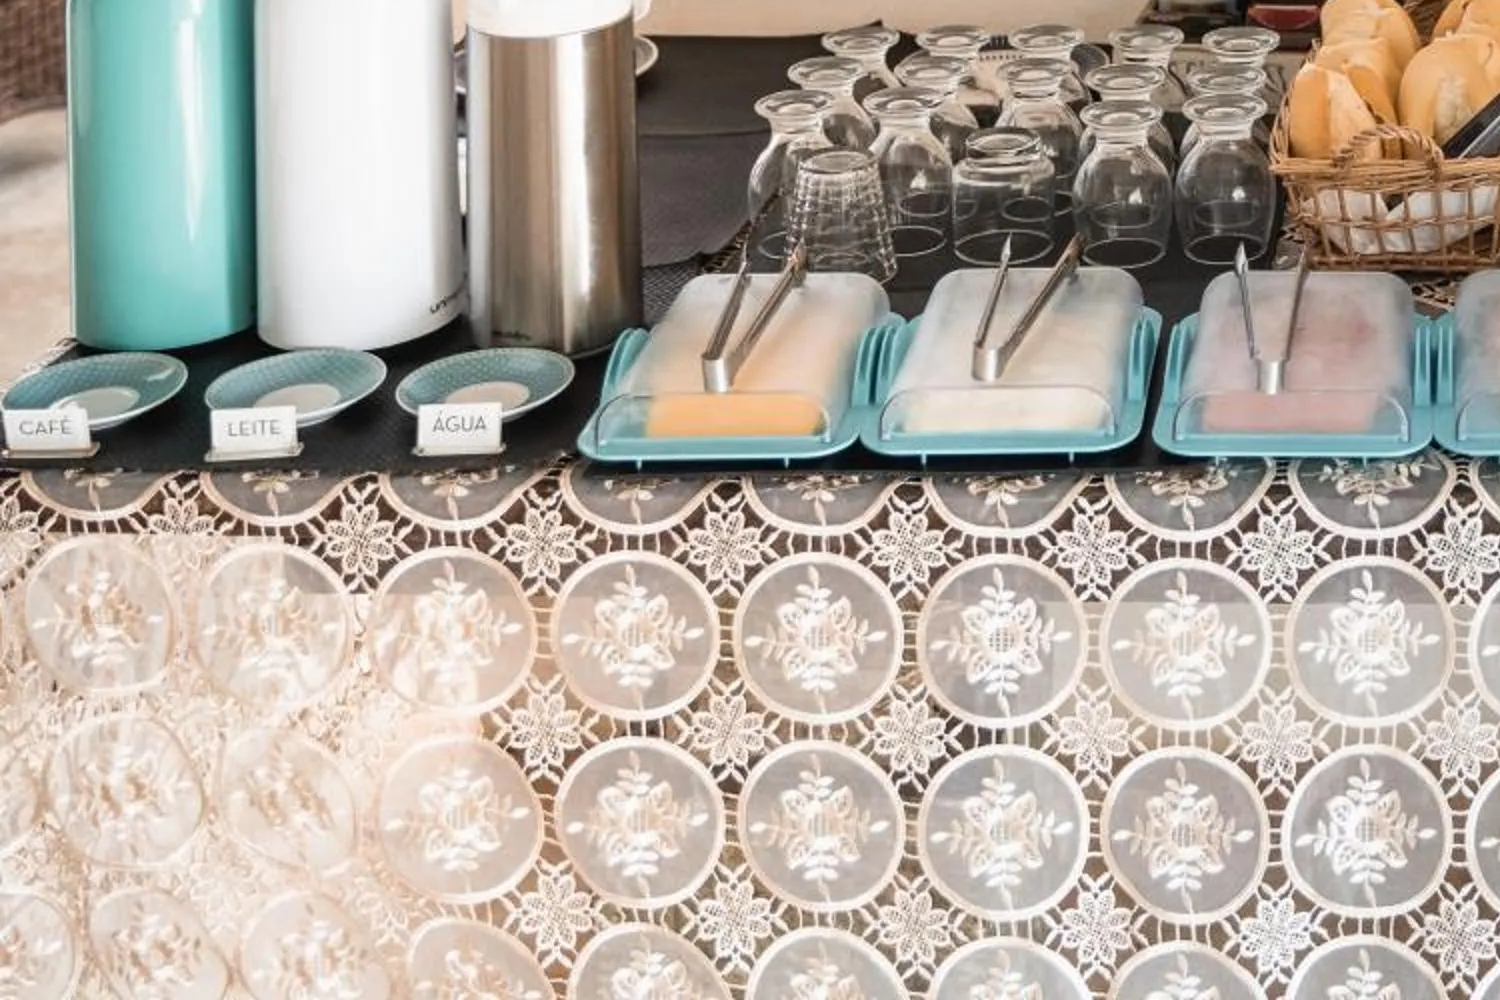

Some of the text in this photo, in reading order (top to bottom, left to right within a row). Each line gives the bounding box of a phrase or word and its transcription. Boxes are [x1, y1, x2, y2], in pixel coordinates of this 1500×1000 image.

[19, 415, 73, 435] CAFÉ
[227, 418, 281, 437] LEITE
[432, 409, 487, 433] ÁGUA
